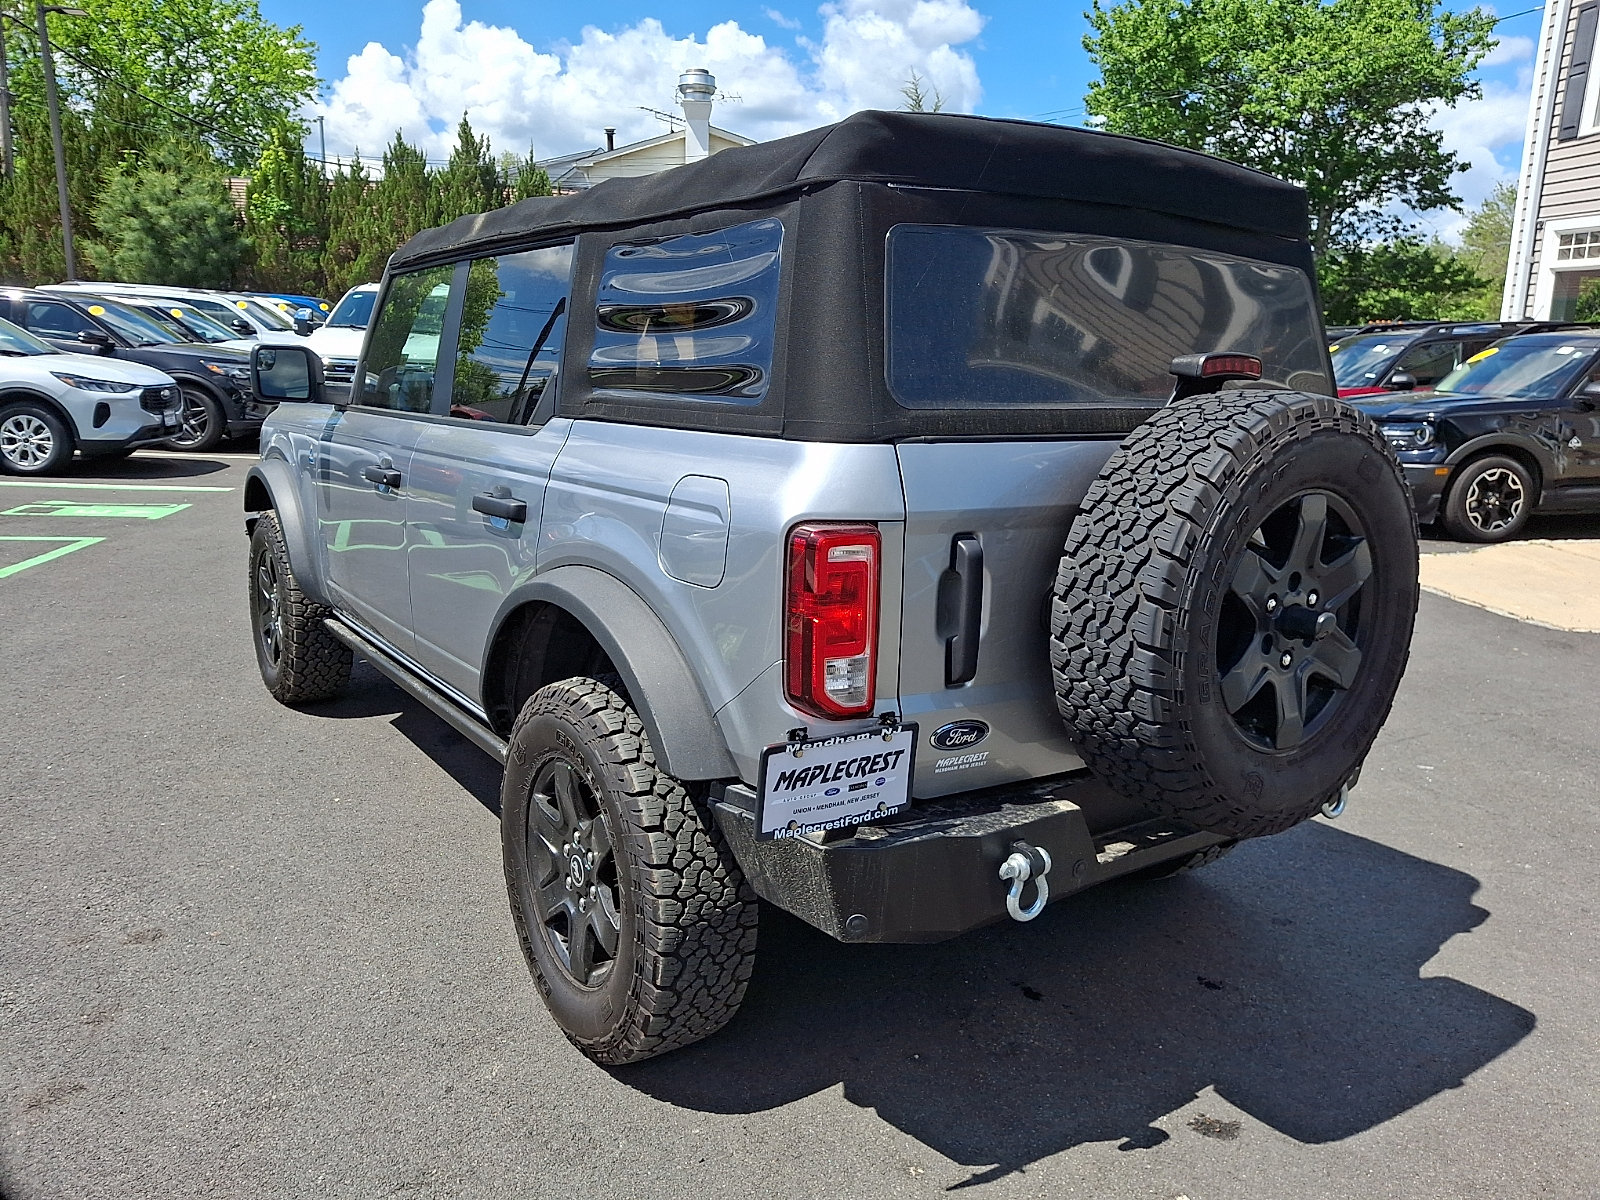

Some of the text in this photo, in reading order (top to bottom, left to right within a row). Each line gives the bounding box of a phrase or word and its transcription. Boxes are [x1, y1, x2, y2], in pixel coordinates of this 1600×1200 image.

[880, 725, 903, 738] NJ
[945, 727, 978, 746] Ford
[935, 751, 990, 768] MAPLECREST
[772, 749, 905, 793] MAPLECREST
[792, 807, 812, 815] UNION
[846, 797, 860, 805] NEW
[859, 792, 881, 802] JERSEY
[773, 806, 899, 840] MaplecrestFord.com
